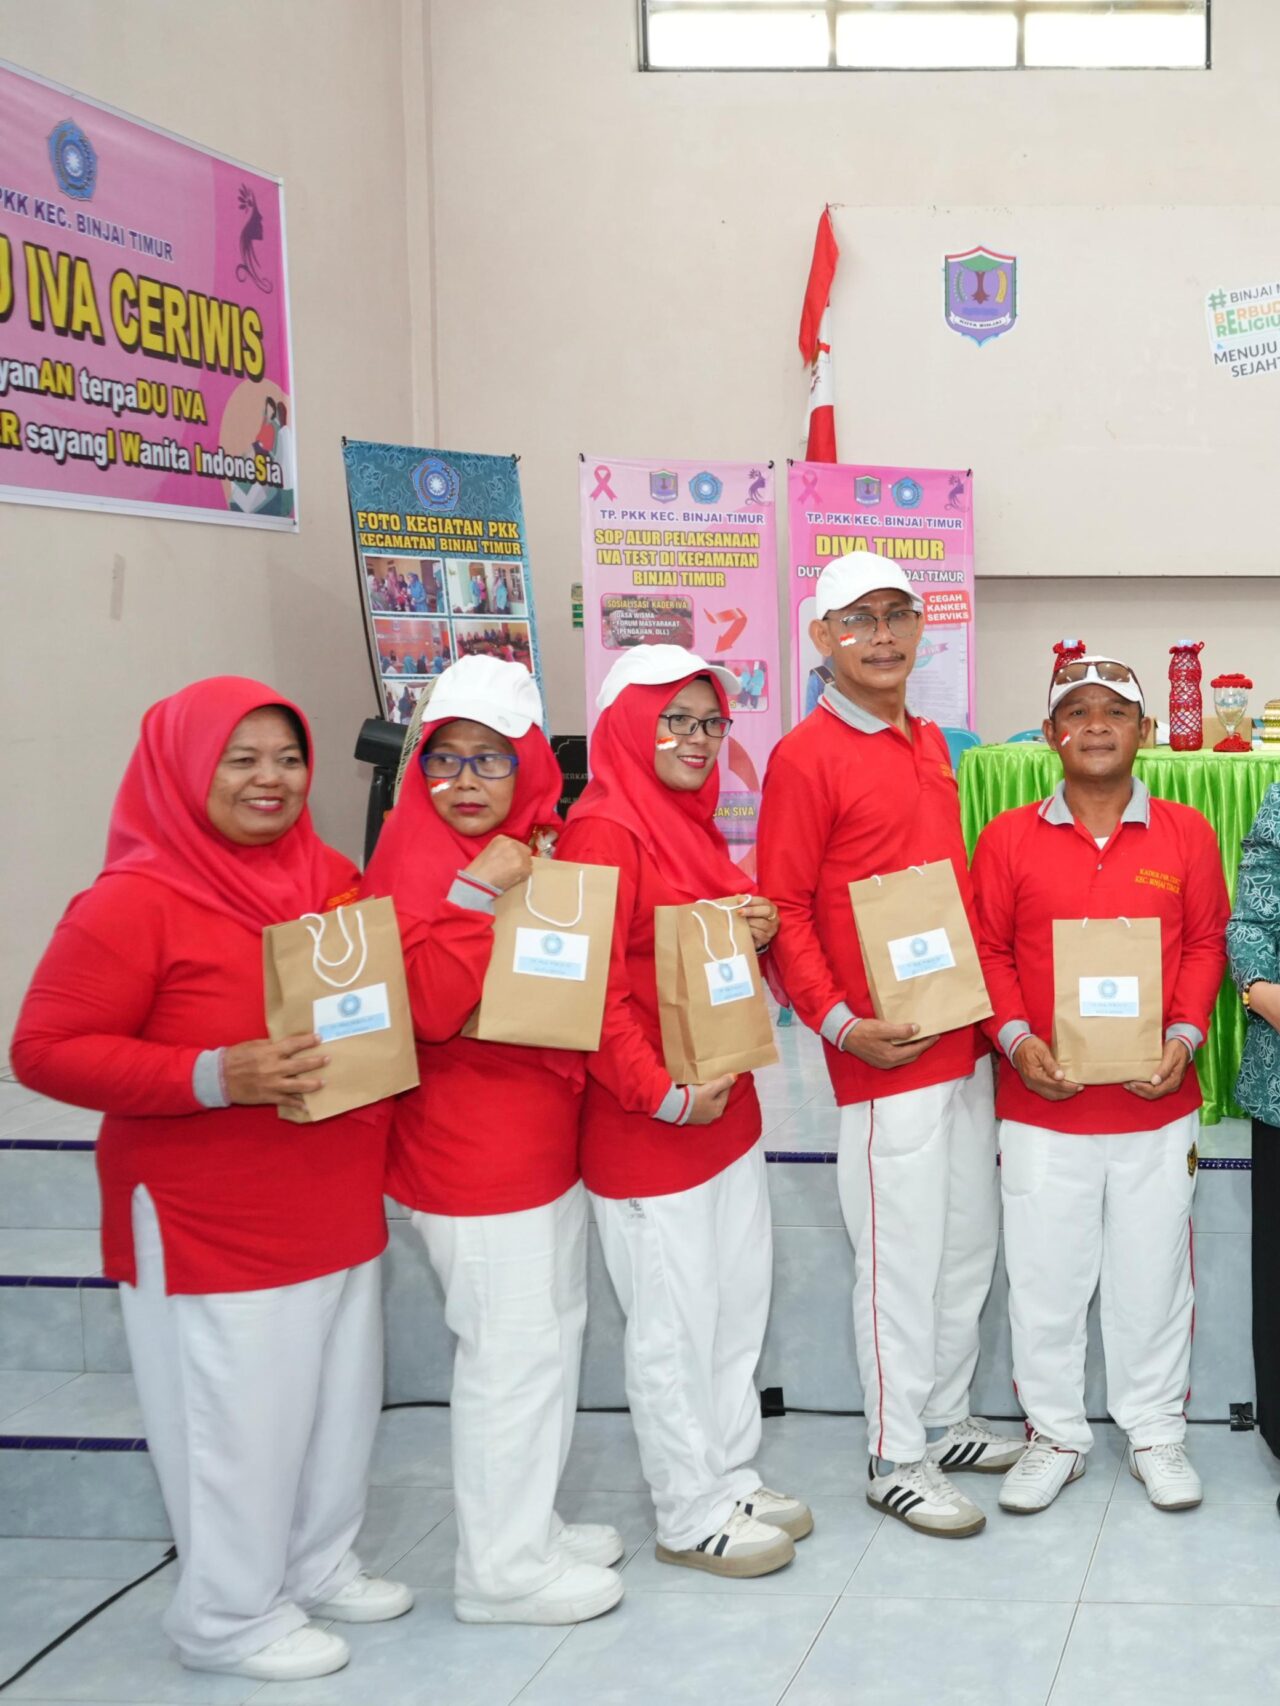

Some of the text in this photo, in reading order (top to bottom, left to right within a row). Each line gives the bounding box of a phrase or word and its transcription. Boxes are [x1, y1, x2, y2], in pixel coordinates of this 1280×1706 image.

[34, 199, 72, 229] KEC.
[77, 213, 125, 246] BINJAI
[129, 230, 173, 261] TIMUR
[1230, 286, 1272, 303] BINJAI
[23, 241, 105, 345] IVA
[110, 268, 265, 382] CERIWIS
[1214, 341, 1277, 364] MENUJU
[79, 367, 168, 415] terpaDU
[172, 386, 208, 424] IVA
[26, 422, 116, 468] sayangI
[120, 430, 191, 474] Wanita
[195, 442, 283, 488] IndoneSia
[357, 512, 519, 538] FOTO KEGIATAN PKK
[600, 510, 764, 523] TP. PKK KEC. BINJAI TIMUR
[807, 513, 962, 528] TP. PKK KEC. BINJAI TIMUR
[360, 532, 521, 555] KECAMATAN BINJAI TIMUR
[595, 529, 760, 548] SOP ALUR PELAKSANAAN
[816, 535, 945, 560] DIVA TIMUR
[597, 549, 759, 568] IVA TEST DI KECAMATAN
[633, 570, 726, 587] BINJAI TIMUR
[927, 570, 964, 582] TIMUR
[927, 603, 967, 612] KANKER
[930, 595, 962, 603] CEGAH
[928, 612, 968, 621] SERVIKS
[733, 807, 754, 816] SIVA
